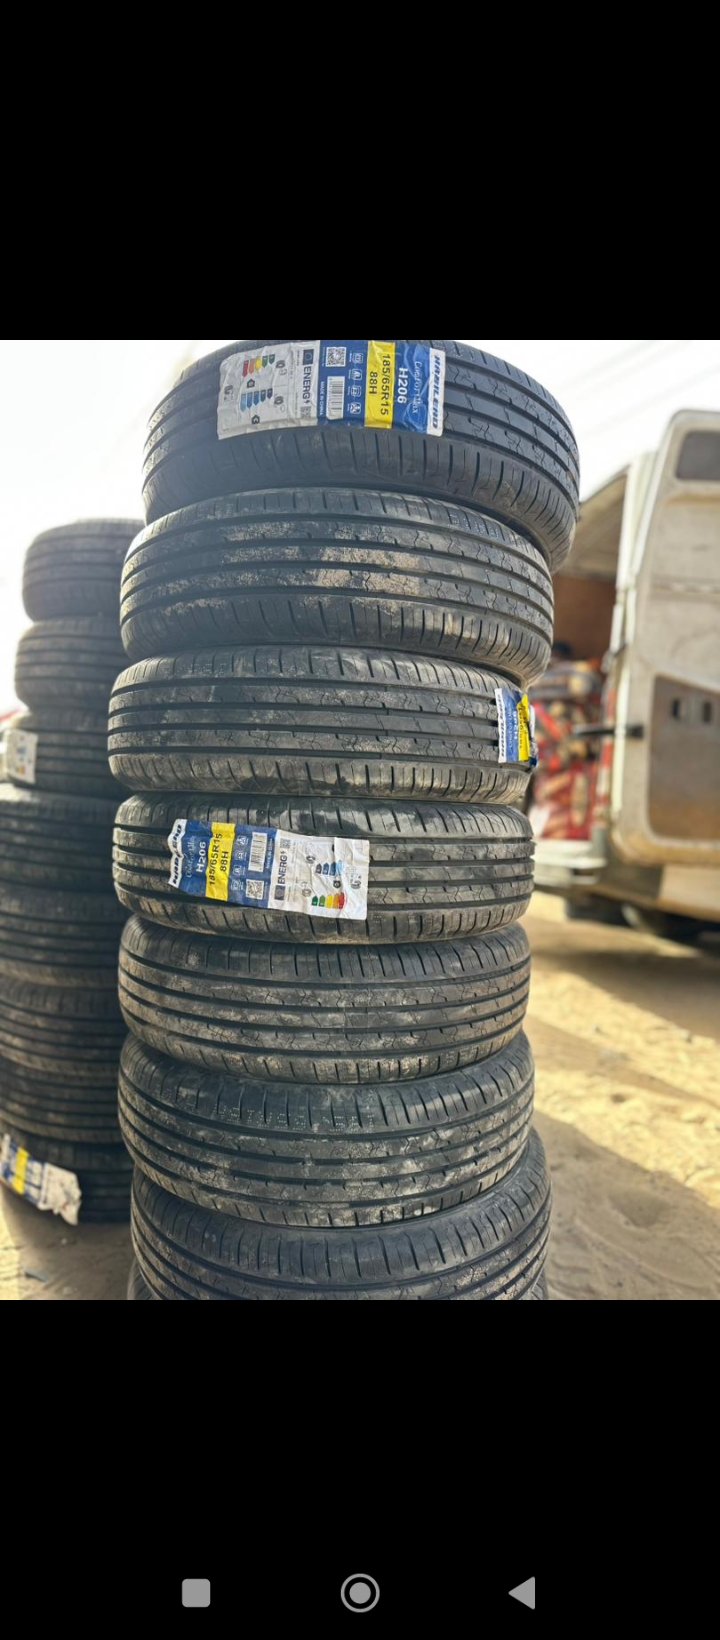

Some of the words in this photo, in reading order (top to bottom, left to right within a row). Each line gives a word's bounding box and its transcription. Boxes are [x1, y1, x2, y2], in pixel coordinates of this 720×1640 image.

[368, 371, 378, 395] 88H
[380, 353, 391, 416] 185/65R15
[397, 367, 408, 404] H206
[432, 354, 441, 429] HABILEAD
[196, 841, 207, 873] H206
[209, 833, 223, 885] 185/65R15
[220, 851, 229, 872] 88H
